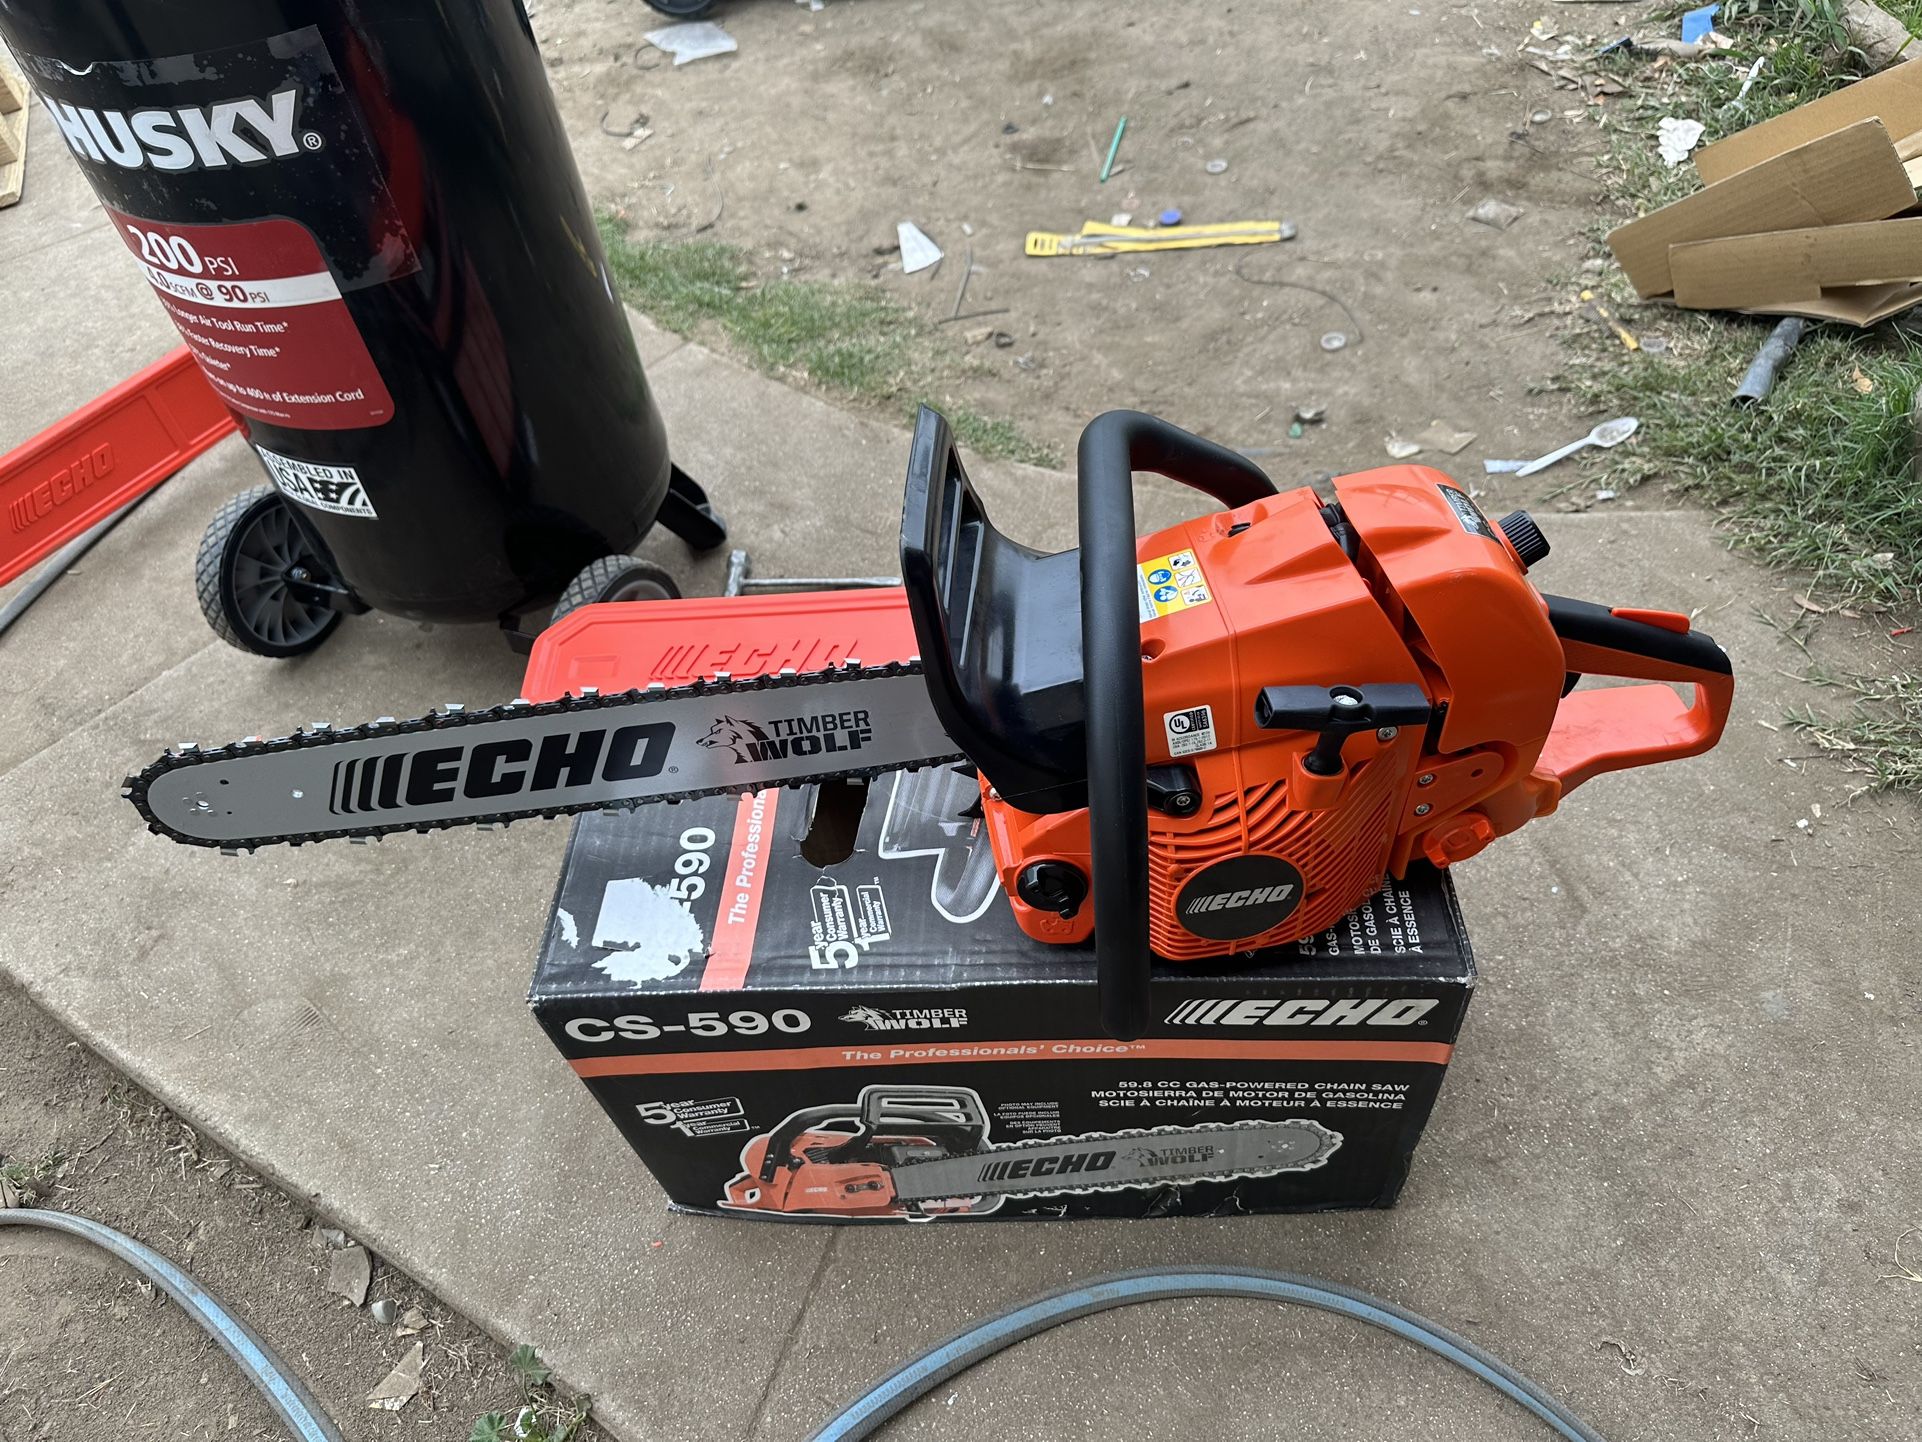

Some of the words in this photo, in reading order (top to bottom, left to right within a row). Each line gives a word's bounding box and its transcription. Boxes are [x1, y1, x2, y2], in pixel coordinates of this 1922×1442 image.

[126, 224, 203, 273] 200
[204, 256, 239, 275] PSI
[169, 282, 198, 298] SCFM
[195, 282, 214, 300] @
[217, 284, 248, 303] 90
[249, 291, 271, 303] PSI
[199, 315, 212, 327] Air
[211, 317, 233, 331] Tool
[234, 319, 257, 333] Run
[208, 337, 250, 358] Recovery
[272, 389, 284, 402] of
[283, 391, 334, 404] Extension
[335, 387, 364, 401] Cord
[260, 448, 334, 480] ASSEMBLED
[336, 469, 355, 481] IN
[32, 441, 114, 519] ECHO
[267, 459, 315, 500] USA
[768, 709, 871, 738] TIMBER
[1173, 717, 1188, 730] UL
[746, 727, 873, 763] WOLF
[735, 789, 768, 888] Professiona
[727, 892, 750, 925] The
[1207, 883, 1295, 912] ECHO
[819, 892, 838, 942] Consumer
[831, 896, 849, 941] Warranty
[860, 891, 878, 933] Commercial
[872, 900, 886, 932] Warranty
[1385, 916, 1401, 925] À
[1398, 890, 1420, 944] ESSENCE
[810, 920, 829, 950] year
[1368, 938, 1382, 954] DE
[1390, 927, 1407, 954] SCIE
[808, 940, 859, 970] 5
[1408, 945, 1424, 954] À
[564, 1009, 812, 1043] CS-590
[875, 1017, 968, 1030] WOLF
[892, 1008, 968, 1019] TIMBER
[842, 1051, 882, 1060] The
[1091, 1090, 1197, 1098] MOTOSIERRA
[1202, 1090, 1224, 1098] DE
[1229, 1090, 1289, 1098] MOTOR
[1294, 1091, 1317, 1099] DE
[1321, 1091, 1406, 1100] GASOLINA
[1118, 1081, 1152, 1089] 59.8
[1185, 1081, 1309, 1089] GAS-POWERED
[1314, 1082, 1366, 1091] CHAIN
[1371, 1083, 1410, 1092] SAW
[635, 1101, 677, 1125] 5
[673, 1101, 732, 1115] Consumer
[676, 1107, 728, 1120] Warranty
[1098, 1099, 1135, 1107] SCIE
[1139, 1098, 1151, 1107] À
[1155, 1098, 1215, 1107] CHAÎNE
[1219, 1098, 1231, 1107] À
[1235, 1099, 1305, 1107] MOTEUR
[1309, 1099, 1321, 1107] À
[1326, 1100, 1403, 1109] ESSENCE
[692, 1121, 741, 1131] Commercial
[694, 1126, 731, 1135] Warranty
[1007, 1150, 1117, 1180] ECHO
